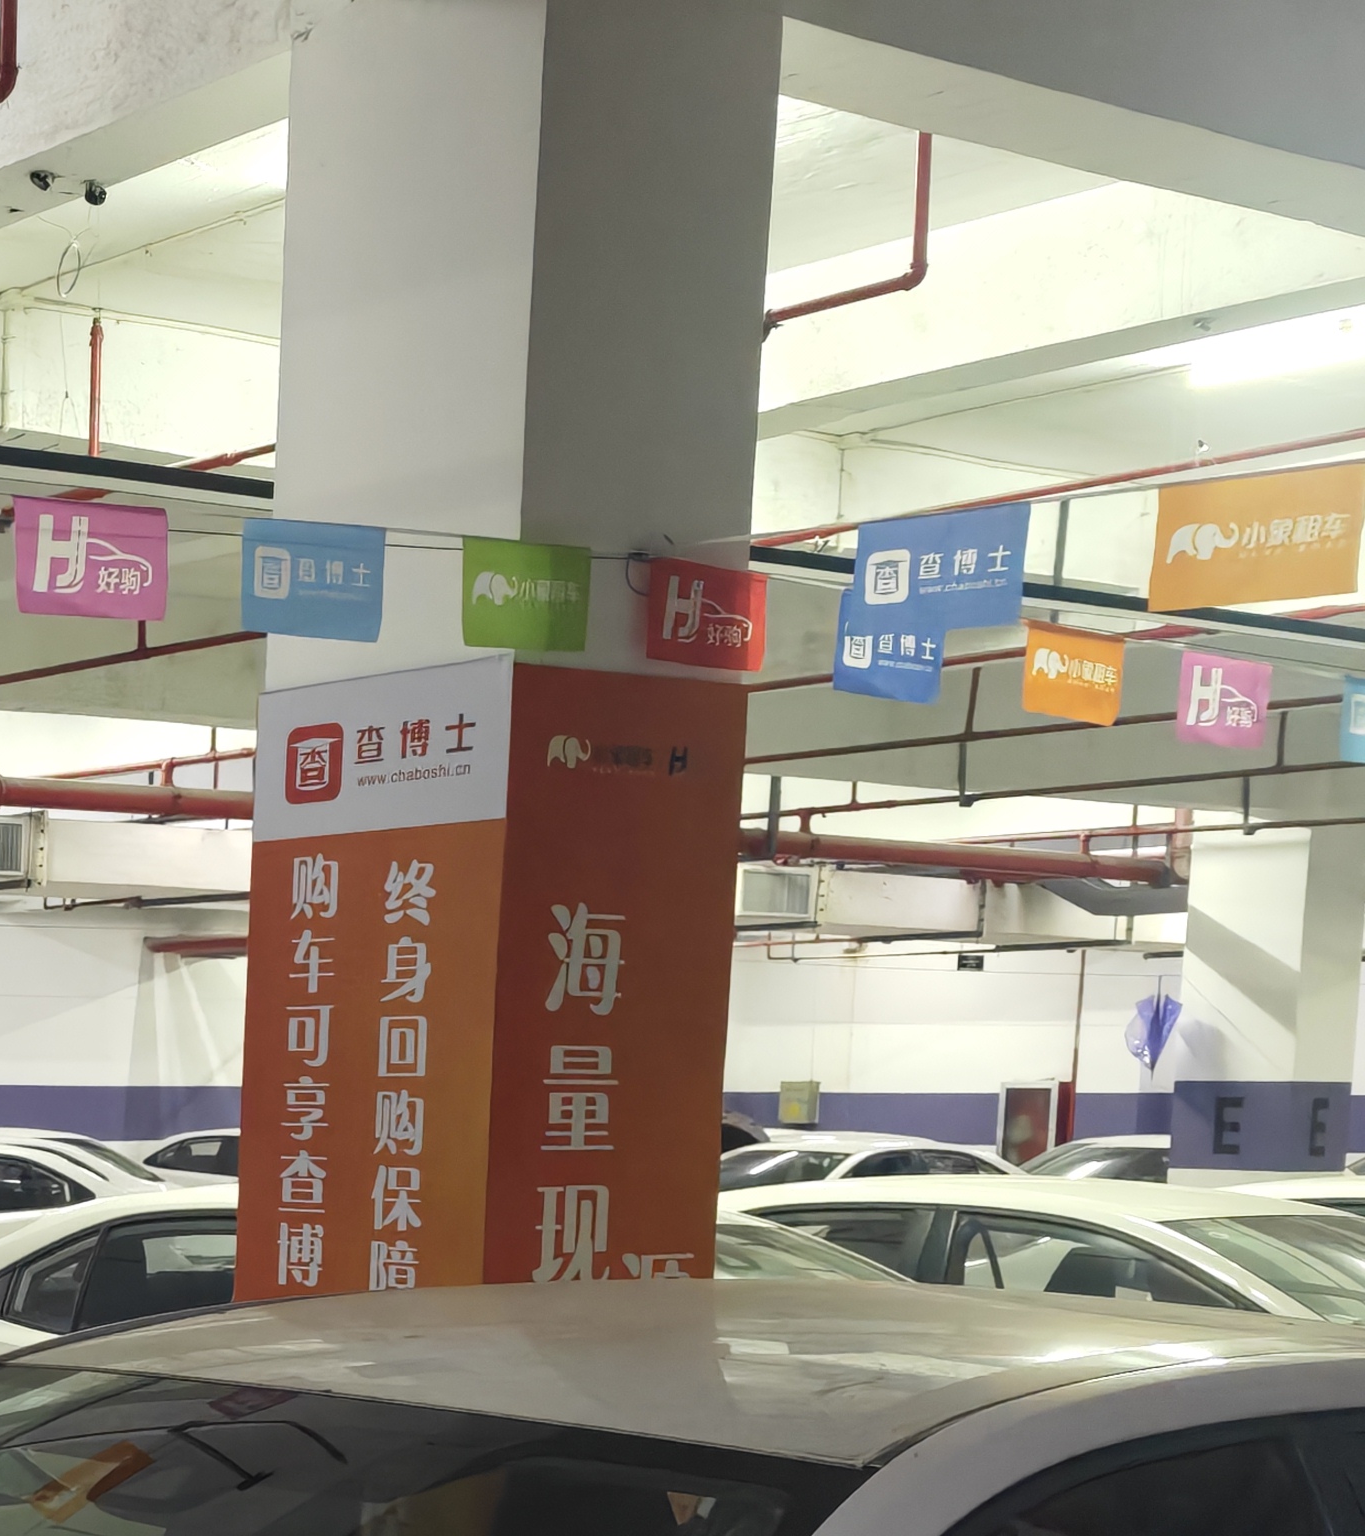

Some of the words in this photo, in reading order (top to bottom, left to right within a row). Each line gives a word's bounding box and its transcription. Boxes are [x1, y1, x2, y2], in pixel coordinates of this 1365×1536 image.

[1241, 512, 1351, 549] 小象租车
[95, 566, 141, 595] 好驹
[917, 544, 1012, 580] 查博士
[354, 712, 477, 765] 查博士
[356, 762, 471, 787] www.chaboshi.cn
[1213, 1097, 1245, 1154] E
[1309, 1098, 1329, 1156] E
